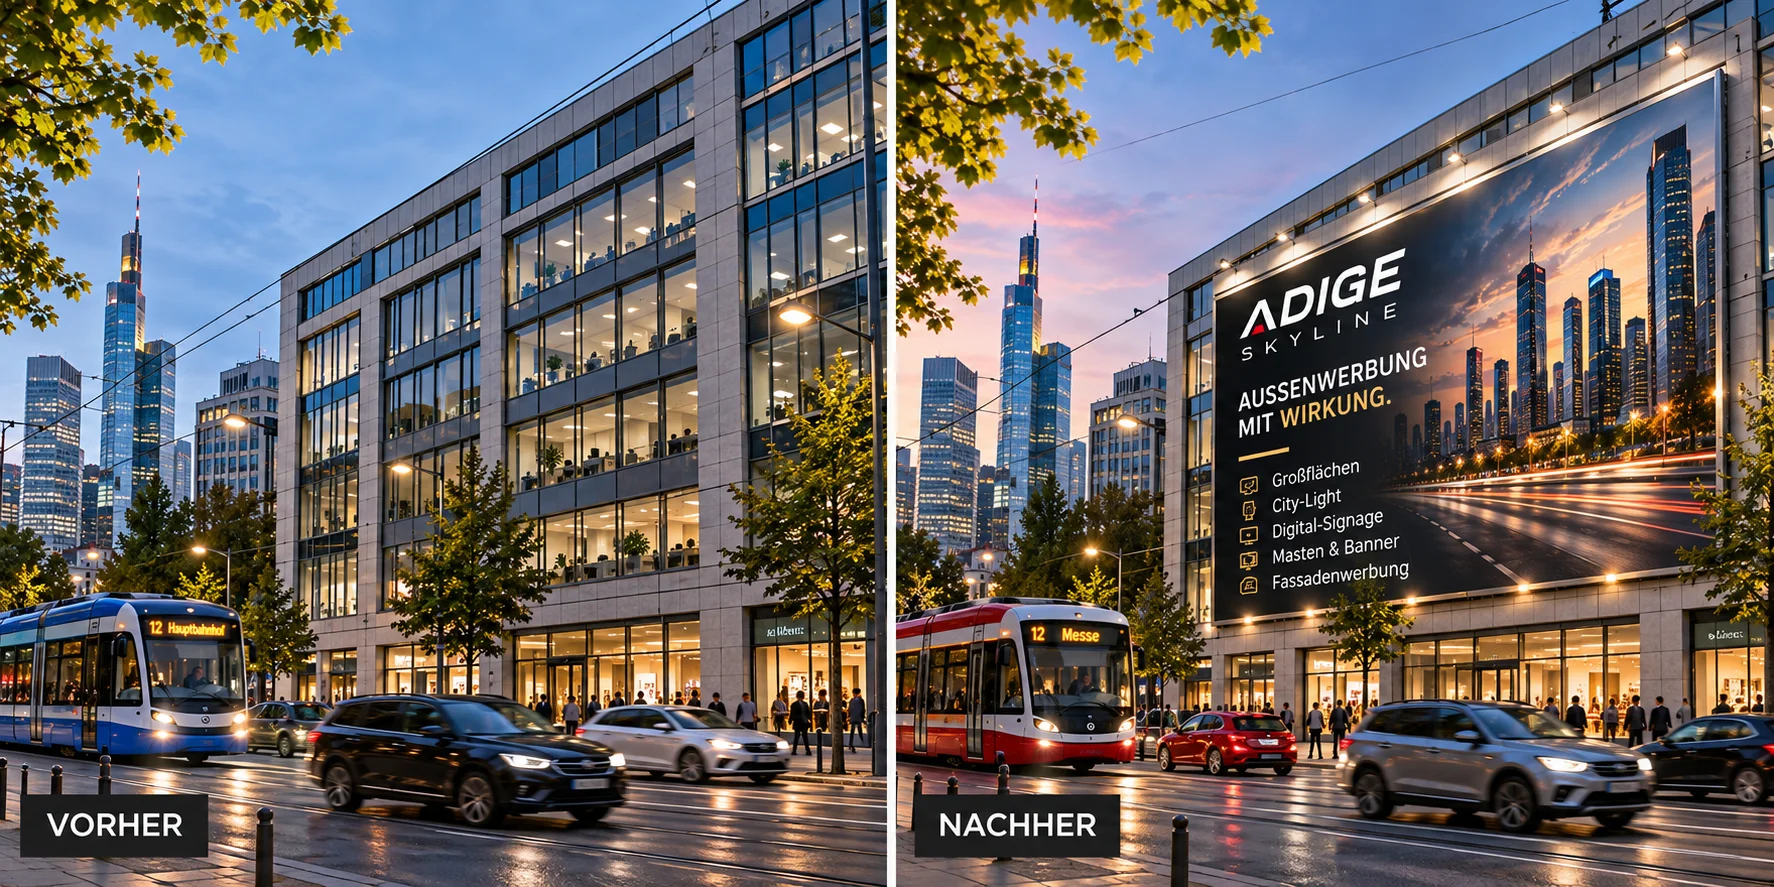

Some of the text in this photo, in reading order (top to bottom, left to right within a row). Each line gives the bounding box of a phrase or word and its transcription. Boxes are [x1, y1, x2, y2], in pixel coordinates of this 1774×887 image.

[1239, 247, 1406, 340] ADIGE
[1241, 302, 1397, 361] SKYLINE
[1238, 346, 1428, 412] AUSSENWERBUNG
[1238, 385, 1392, 439] MIT WIRKUNG.
[1272, 460, 1360, 488] Großflächen
[1272, 488, 1342, 514] City-Light
[1272, 511, 1384, 541] Digital-Signage
[1272, 535, 1400, 565] Masten & Banner
[1272, 562, 1410, 590] Fassadenwerbung
[149, 620, 226, 637] 12 Hauptbahnhof
[1031, 626, 1100, 643] 12 Messe
